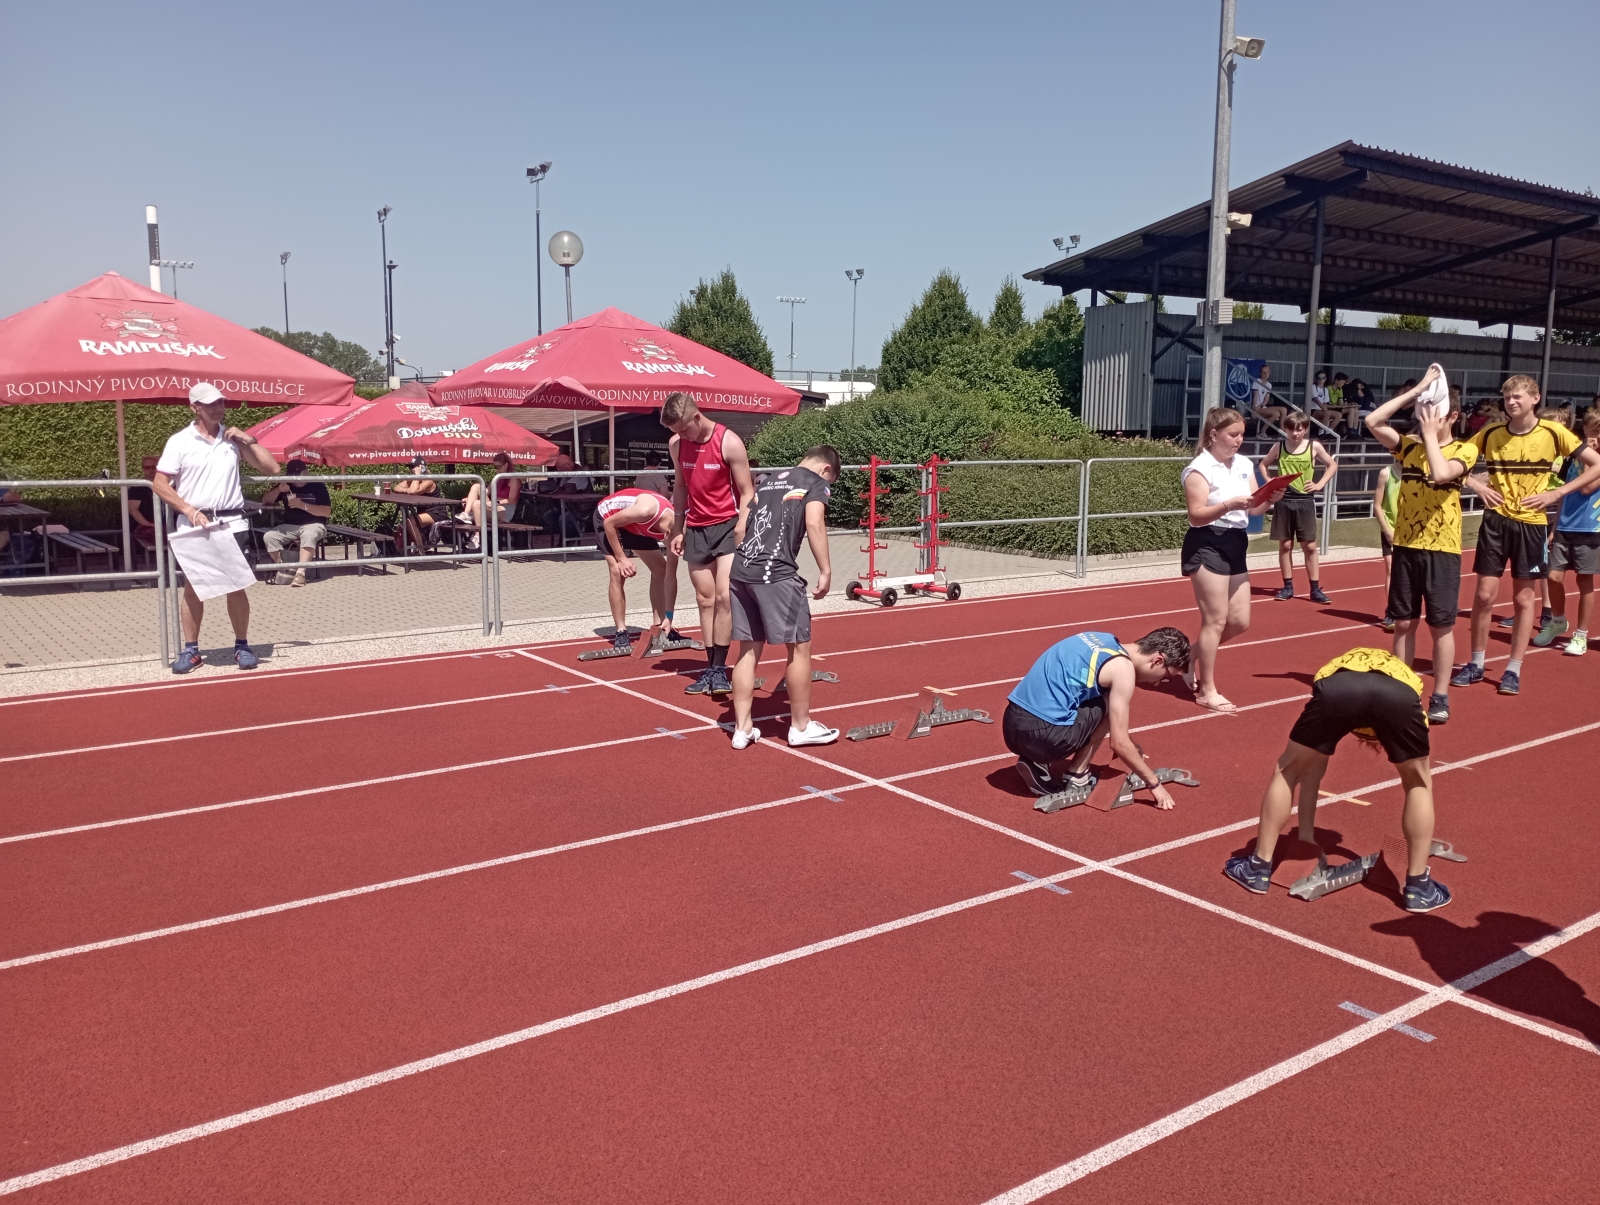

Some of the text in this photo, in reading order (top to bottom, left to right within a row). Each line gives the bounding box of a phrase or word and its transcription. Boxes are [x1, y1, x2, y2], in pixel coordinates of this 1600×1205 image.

[78, 339, 227, 359] RAMPUŠÁK
[621, 360, 716, 377] RAMPUŠÁK
[5, 375, 306, 397] RODINNÝ PIVOVAR DOBRUŠCE
[498, 386, 531, 399] DOBRUŠC
[653, 390, 703, 402] PIVAR
[705, 393, 713, 401] V
[714, 393, 772, 407] DOBRUŠCE
[348, 448, 450, 460] www.pivovardobruska.cz
